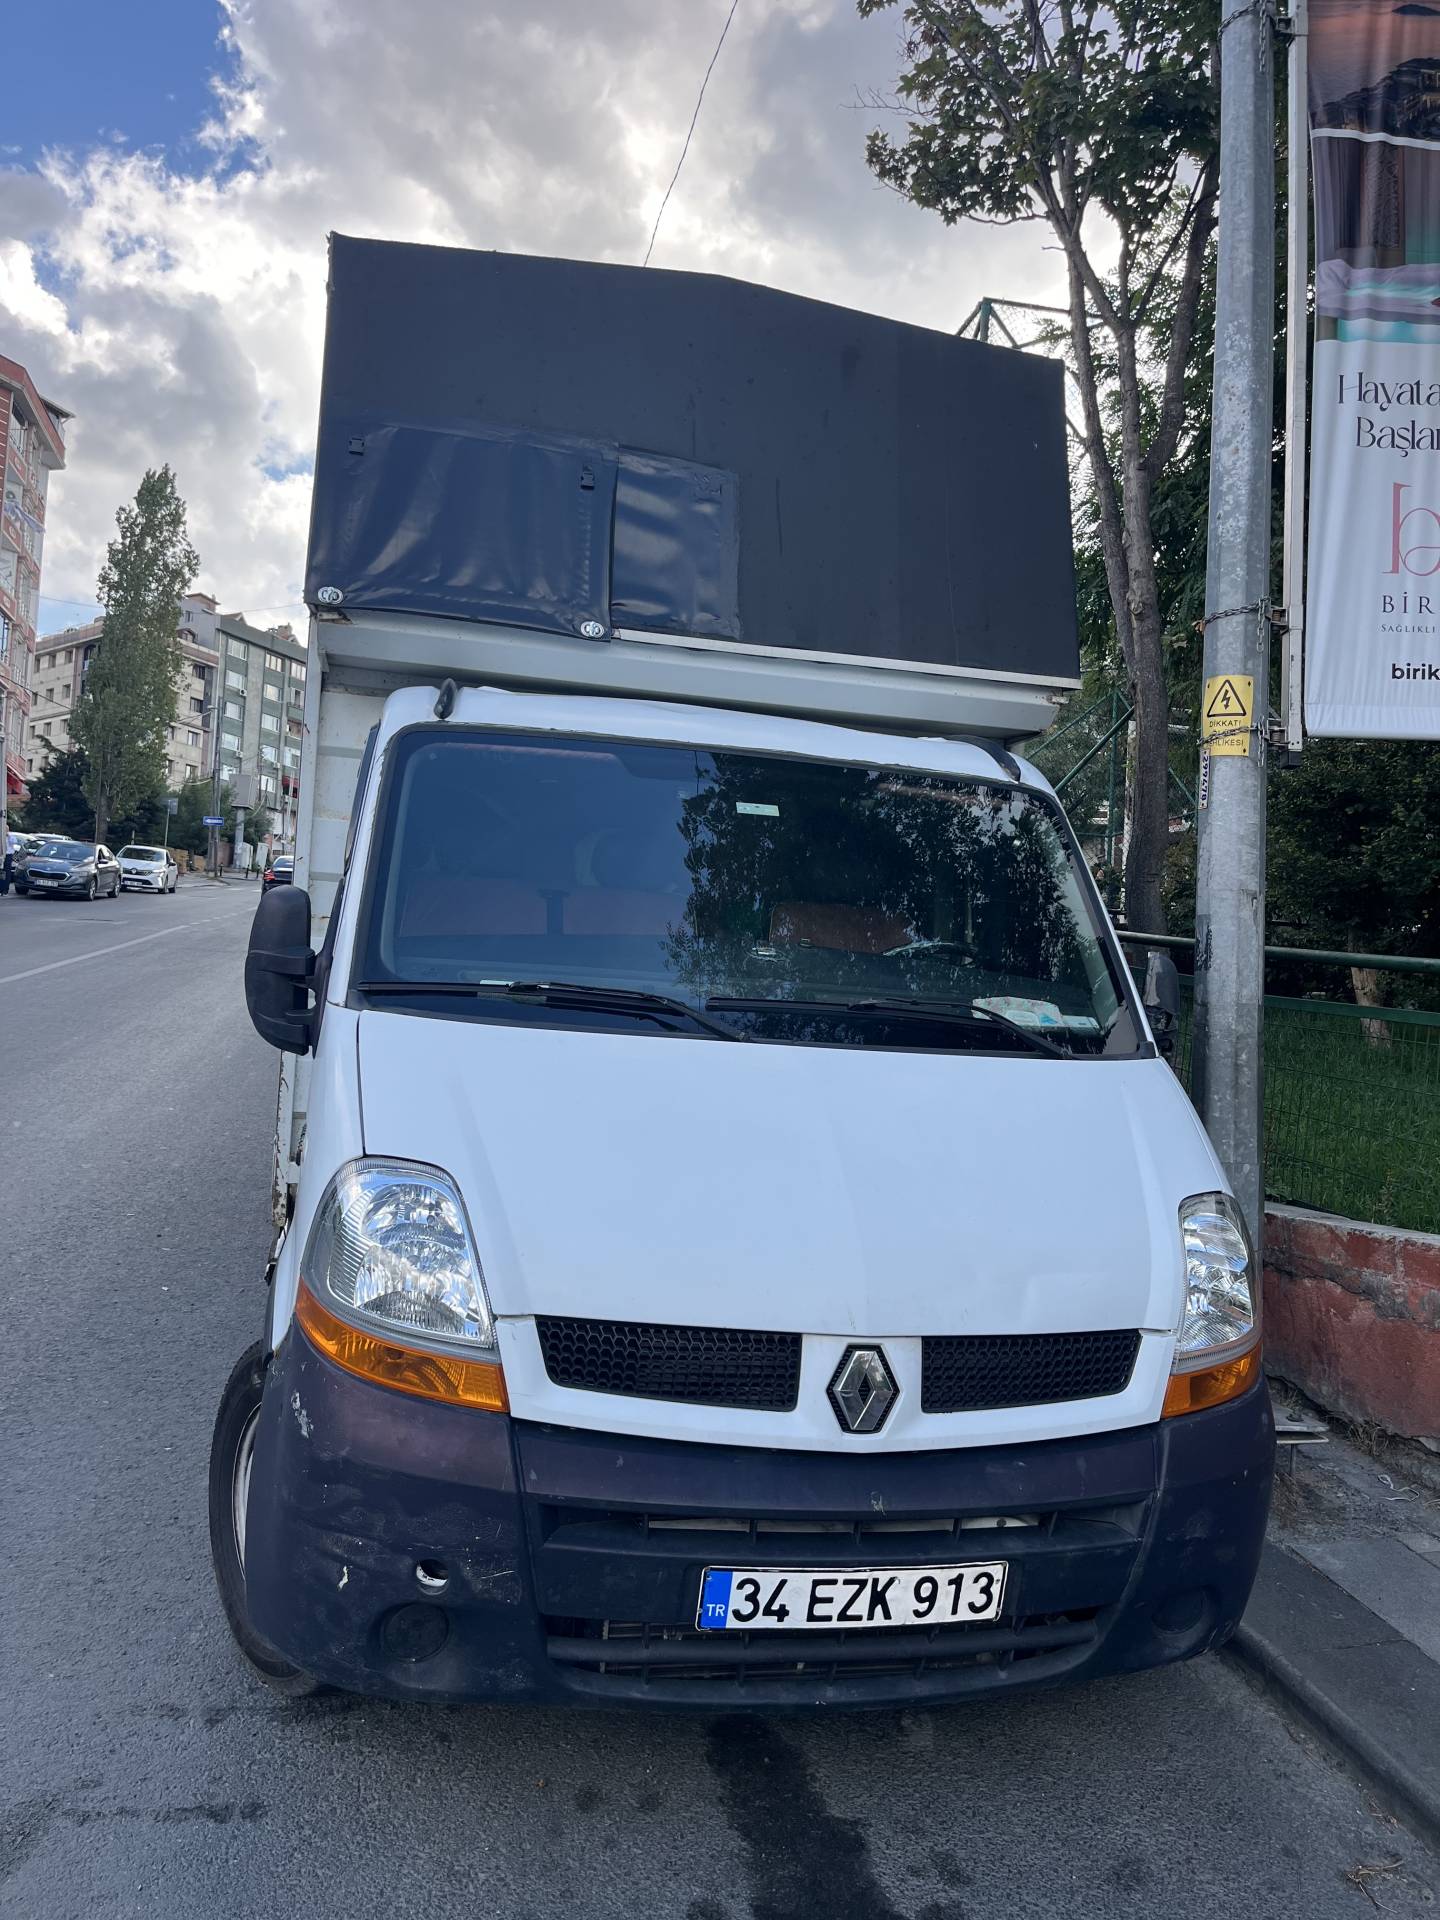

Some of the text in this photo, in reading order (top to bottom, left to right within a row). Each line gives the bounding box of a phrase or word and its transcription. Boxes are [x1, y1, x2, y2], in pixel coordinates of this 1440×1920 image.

[1338, 372, 1440, 412] Hayata
[1382, 591, 1435, 614] BİR
[1391, 662, 1440, 681] birik
[731, 1571, 995, 1623] 34 EZK 913
[706, 1603, 725, 1617] TR
